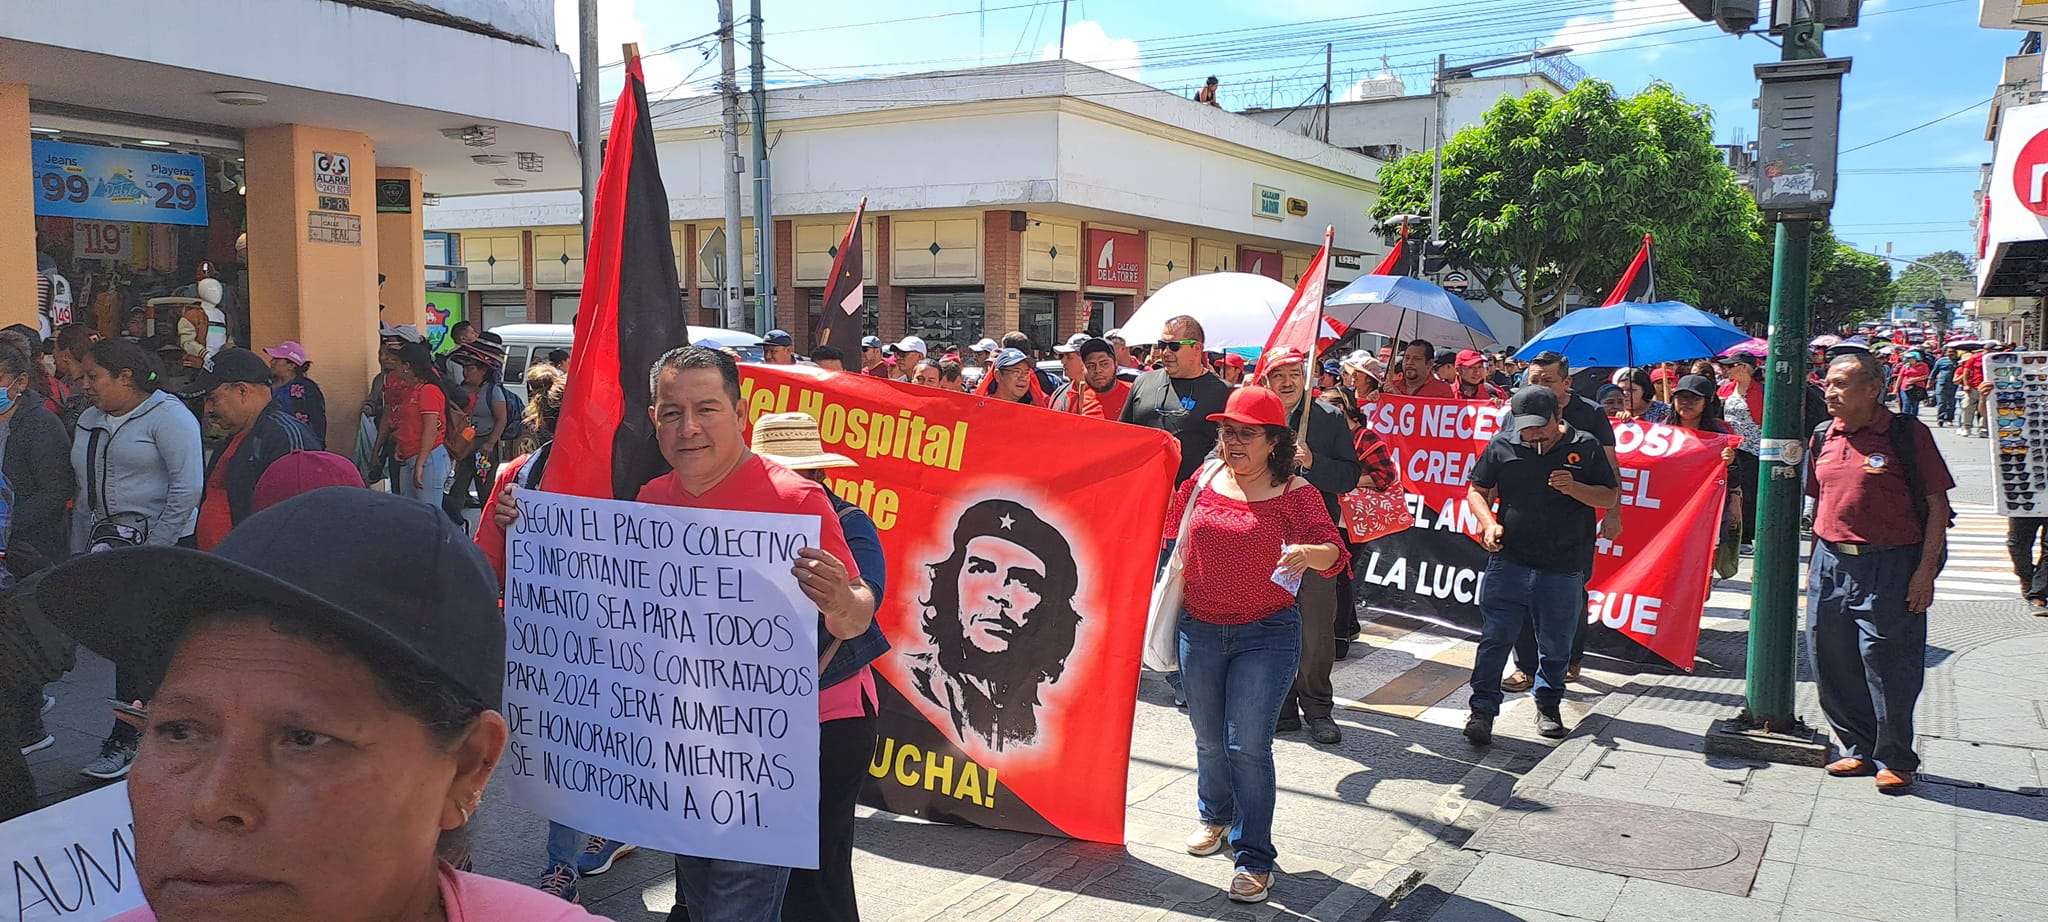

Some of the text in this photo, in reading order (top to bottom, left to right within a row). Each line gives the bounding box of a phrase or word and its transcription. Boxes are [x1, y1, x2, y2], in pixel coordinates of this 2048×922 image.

[45, 155, 78, 166] Jeans
[151, 164, 196, 176] Playeras
[316, 175, 349, 186] ALARM
[41, 172, 90, 203] 99
[154, 182, 196, 211] 29
[84, 224, 121, 254] 119
[1338, 255, 1360, 266] URBA
[1117, 263, 1139, 271] CALZADO
[799, 389, 969, 471] Hospital
[514, 497, 808, 564] SEGÚN EL PACTO COLECTIVO
[512, 540, 754, 603] ES IMPORTANTE QUE EL
[1365, 551, 1407, 590] LA
[511, 578, 794, 652] AUMENTO SEA PARA TODOS
[512, 616, 813, 697] SOLO QUE LOS CONTRATADOS
[507, 660, 789, 739] PARA 2024 SERÁ AUMENTO
[508, 702, 795, 791] DE HONORARIO, MIENTRAS
[511, 742, 534, 777] SE
[543, 751, 669, 812] INCORPORAN
[683, 785, 701, 820] A
[13, 823, 136, 922] AUM
